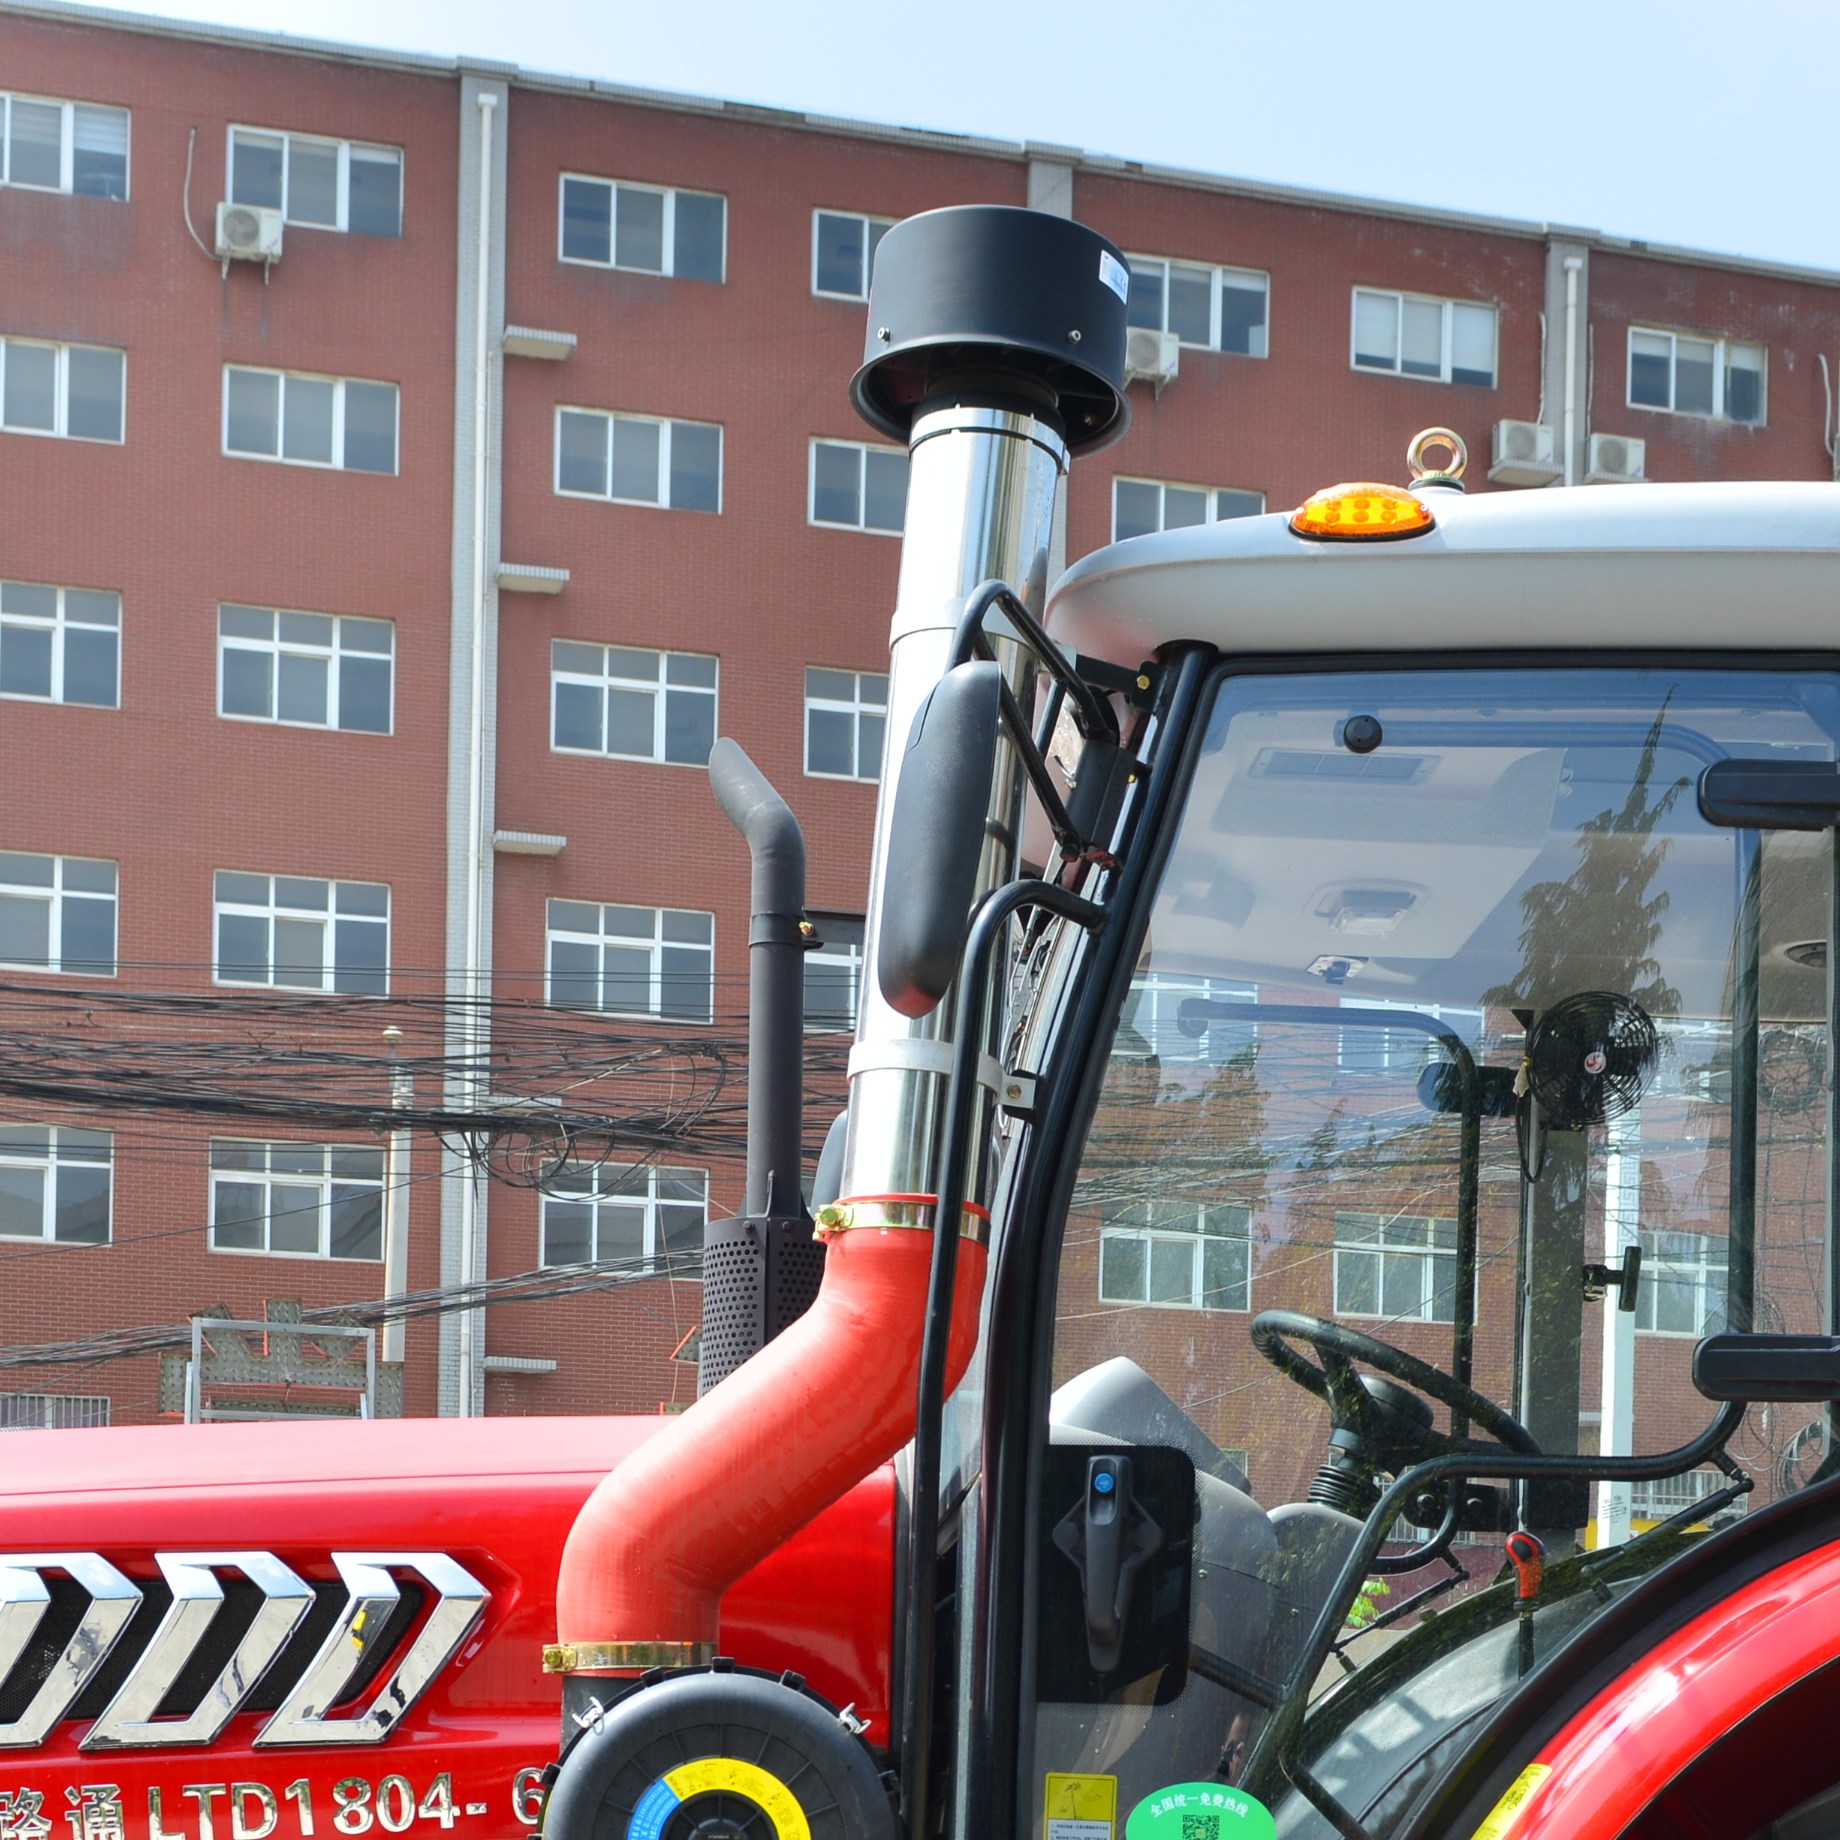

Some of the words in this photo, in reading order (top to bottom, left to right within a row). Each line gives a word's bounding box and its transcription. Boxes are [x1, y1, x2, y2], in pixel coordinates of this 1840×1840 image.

[1150, 1791, 1250, 1819] 全国统一免费热线
